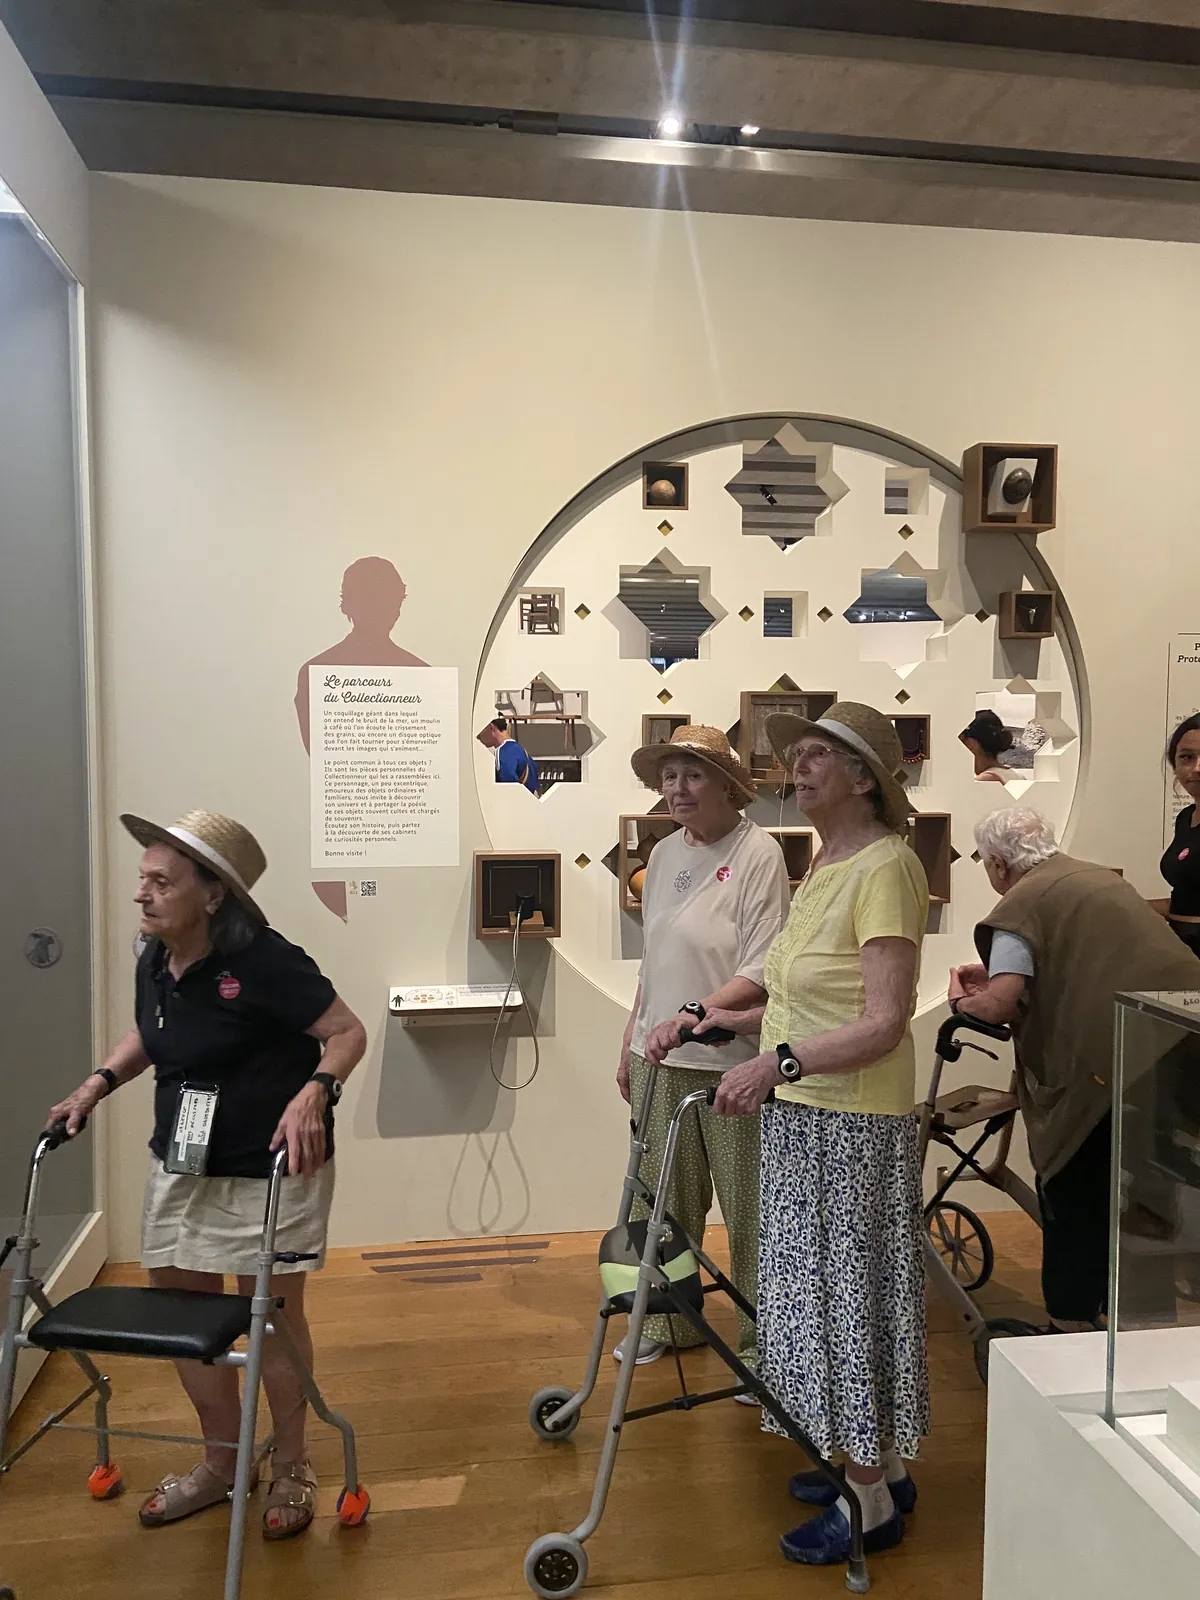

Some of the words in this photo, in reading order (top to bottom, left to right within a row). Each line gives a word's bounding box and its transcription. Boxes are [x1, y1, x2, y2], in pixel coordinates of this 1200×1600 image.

[324, 674, 341, 689] Le
[342, 677, 392, 688] parcours
[324, 693, 338, 702] du
[341, 691, 422, 703] Collectionneur
